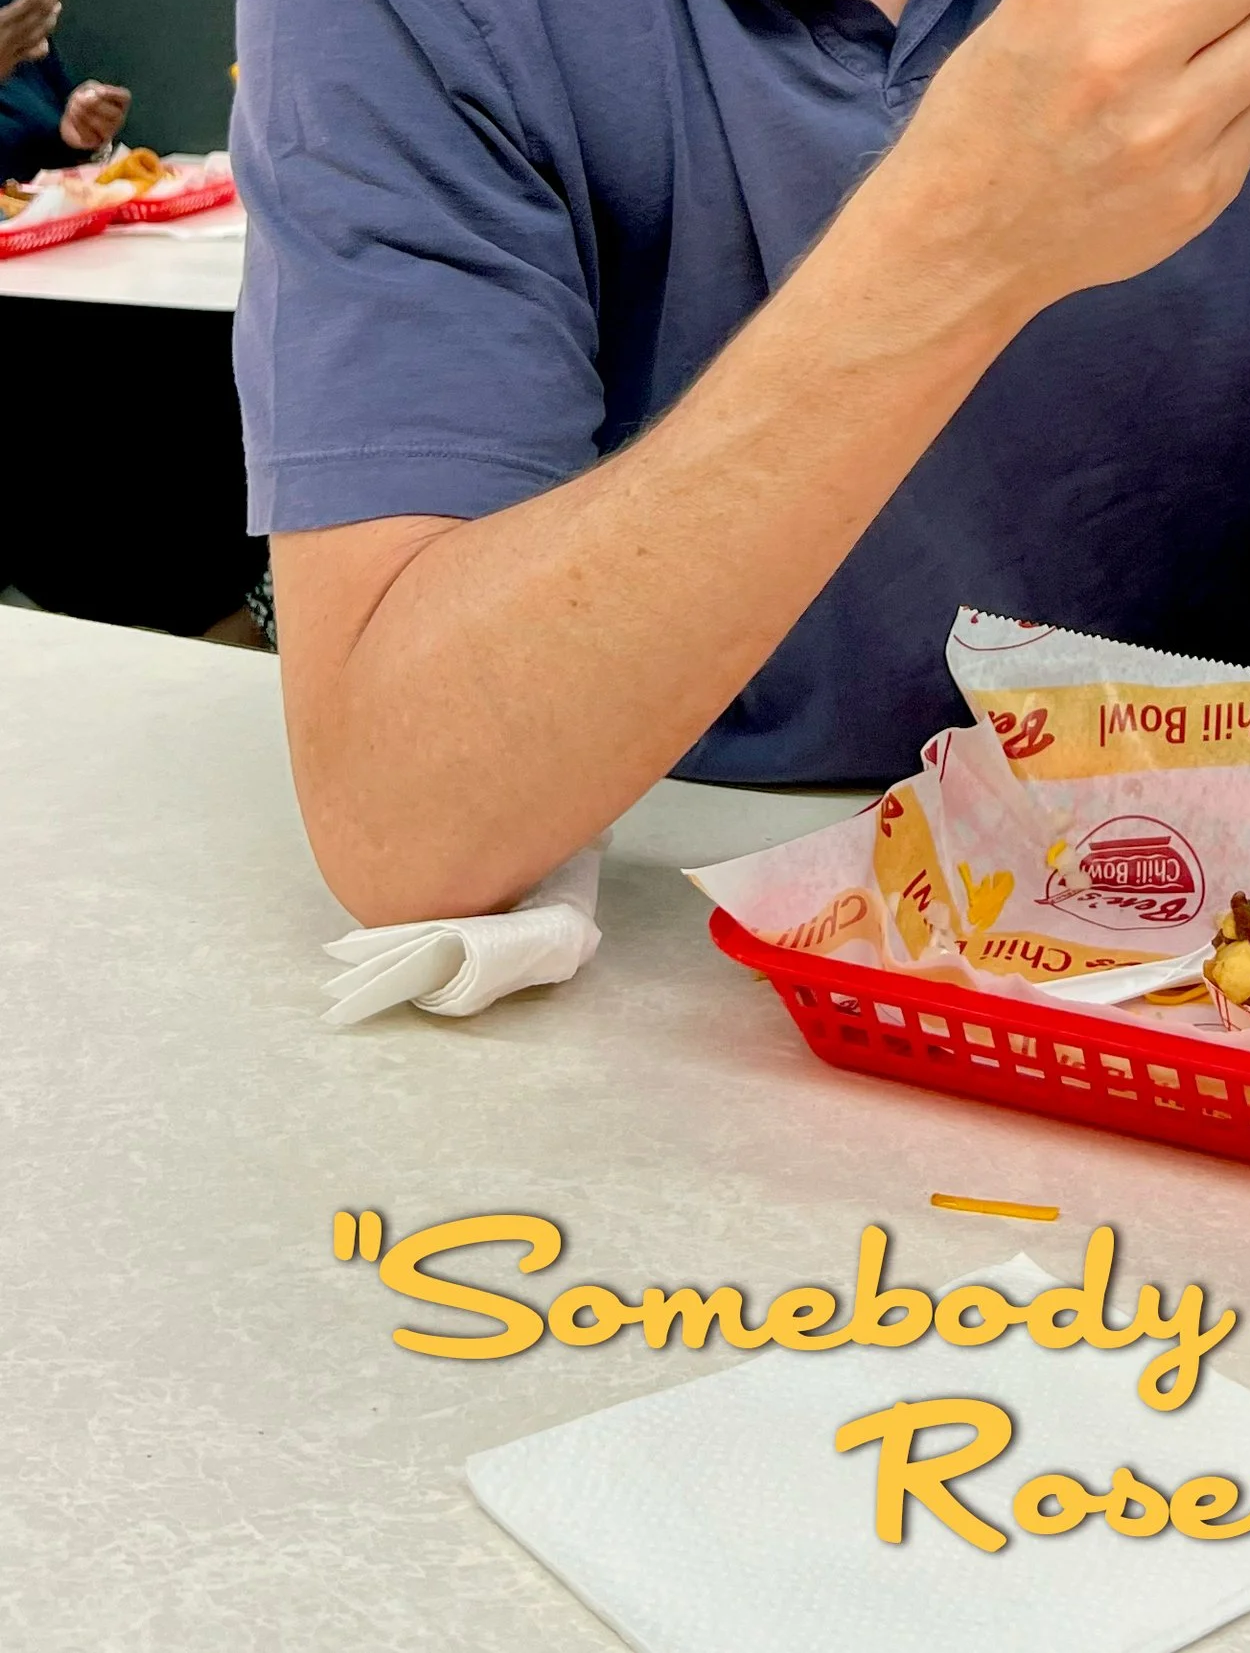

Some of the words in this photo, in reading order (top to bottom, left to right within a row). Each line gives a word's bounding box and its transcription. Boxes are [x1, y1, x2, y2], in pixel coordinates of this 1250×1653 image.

[987, 707, 1056, 760] Be
[1099, 702, 1187, 748] Bowl
[1135, 857, 1181, 884] Chili
[1077, 892, 1191, 922] Ben's
[980, 939, 1073, 973] Chili
